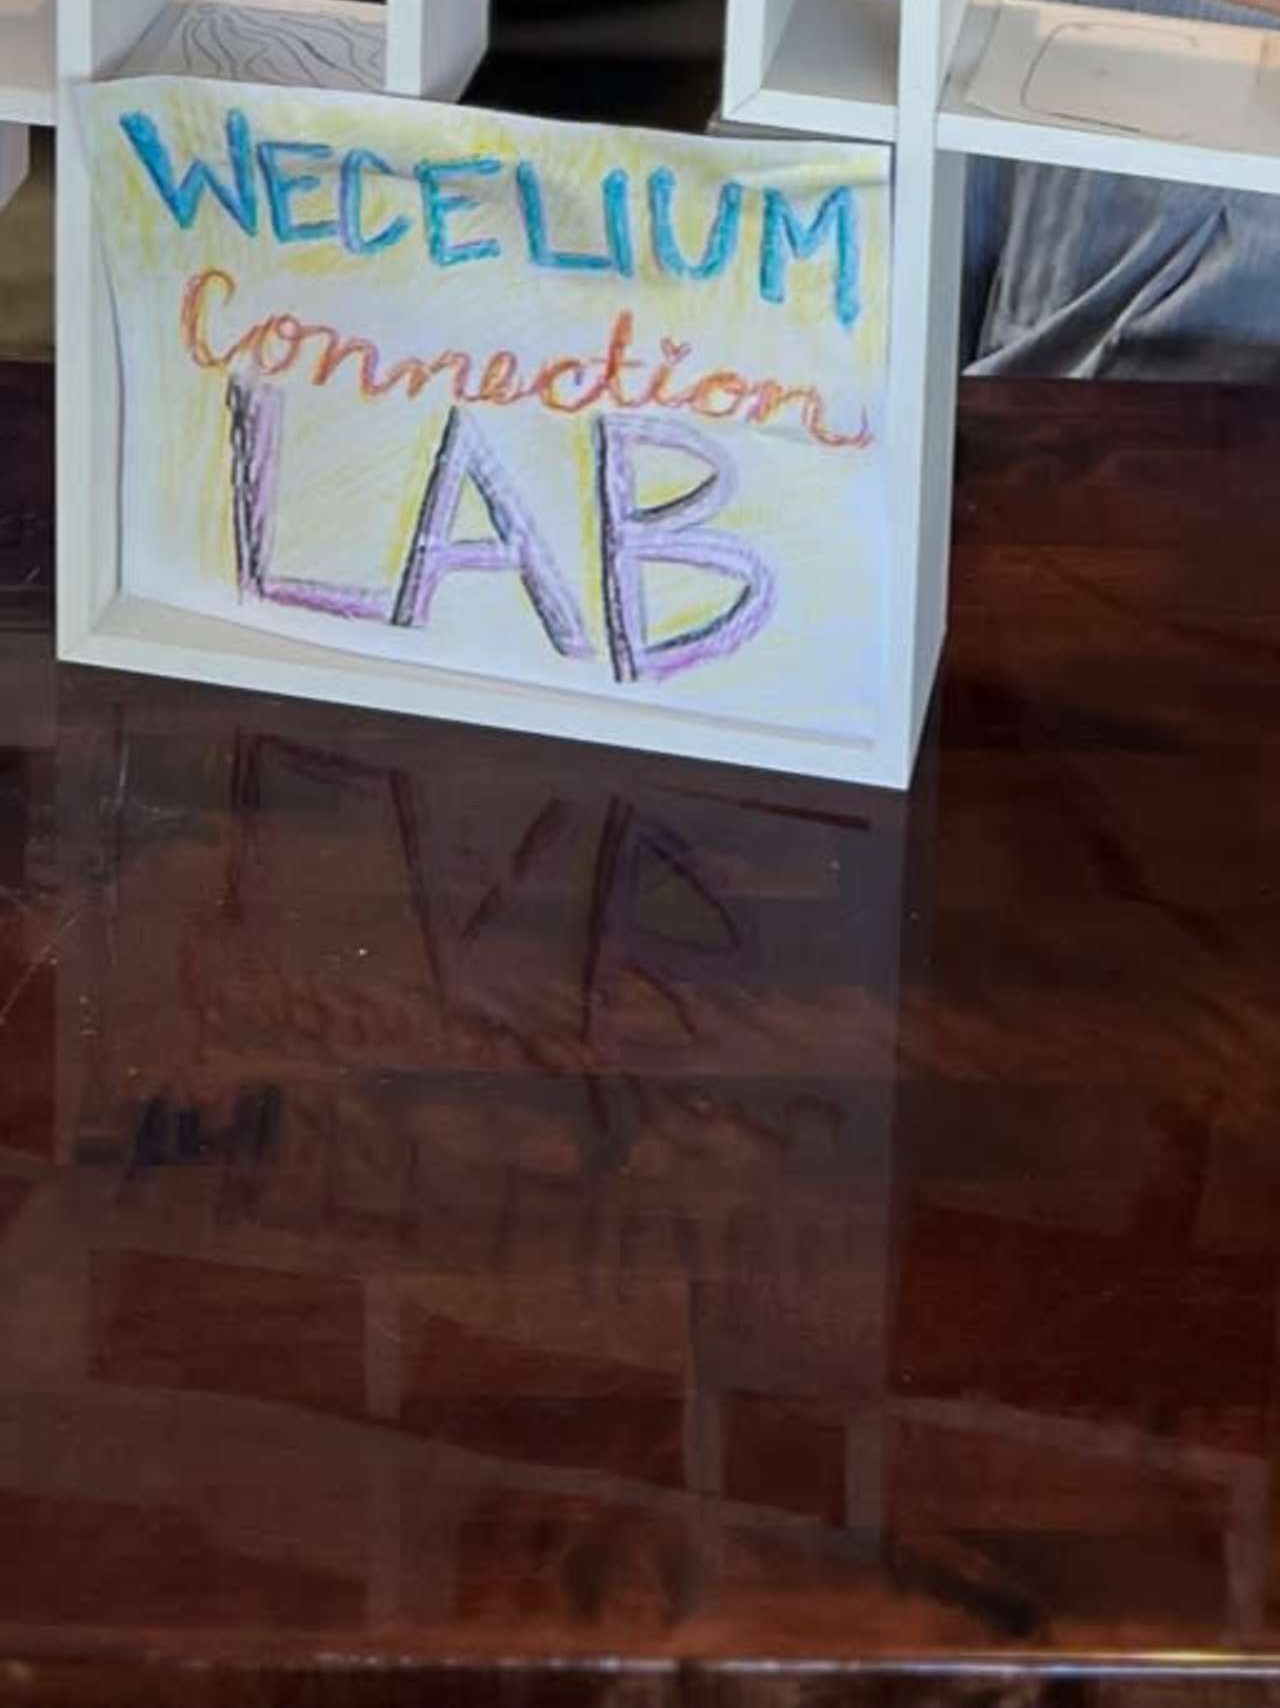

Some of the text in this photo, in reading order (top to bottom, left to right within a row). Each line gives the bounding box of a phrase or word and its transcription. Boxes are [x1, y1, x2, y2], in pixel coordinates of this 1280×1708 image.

[121, 107, 861, 332] WECELIUM
[180, 267, 873, 449] Connection
[224, 377, 779, 684] LAB
